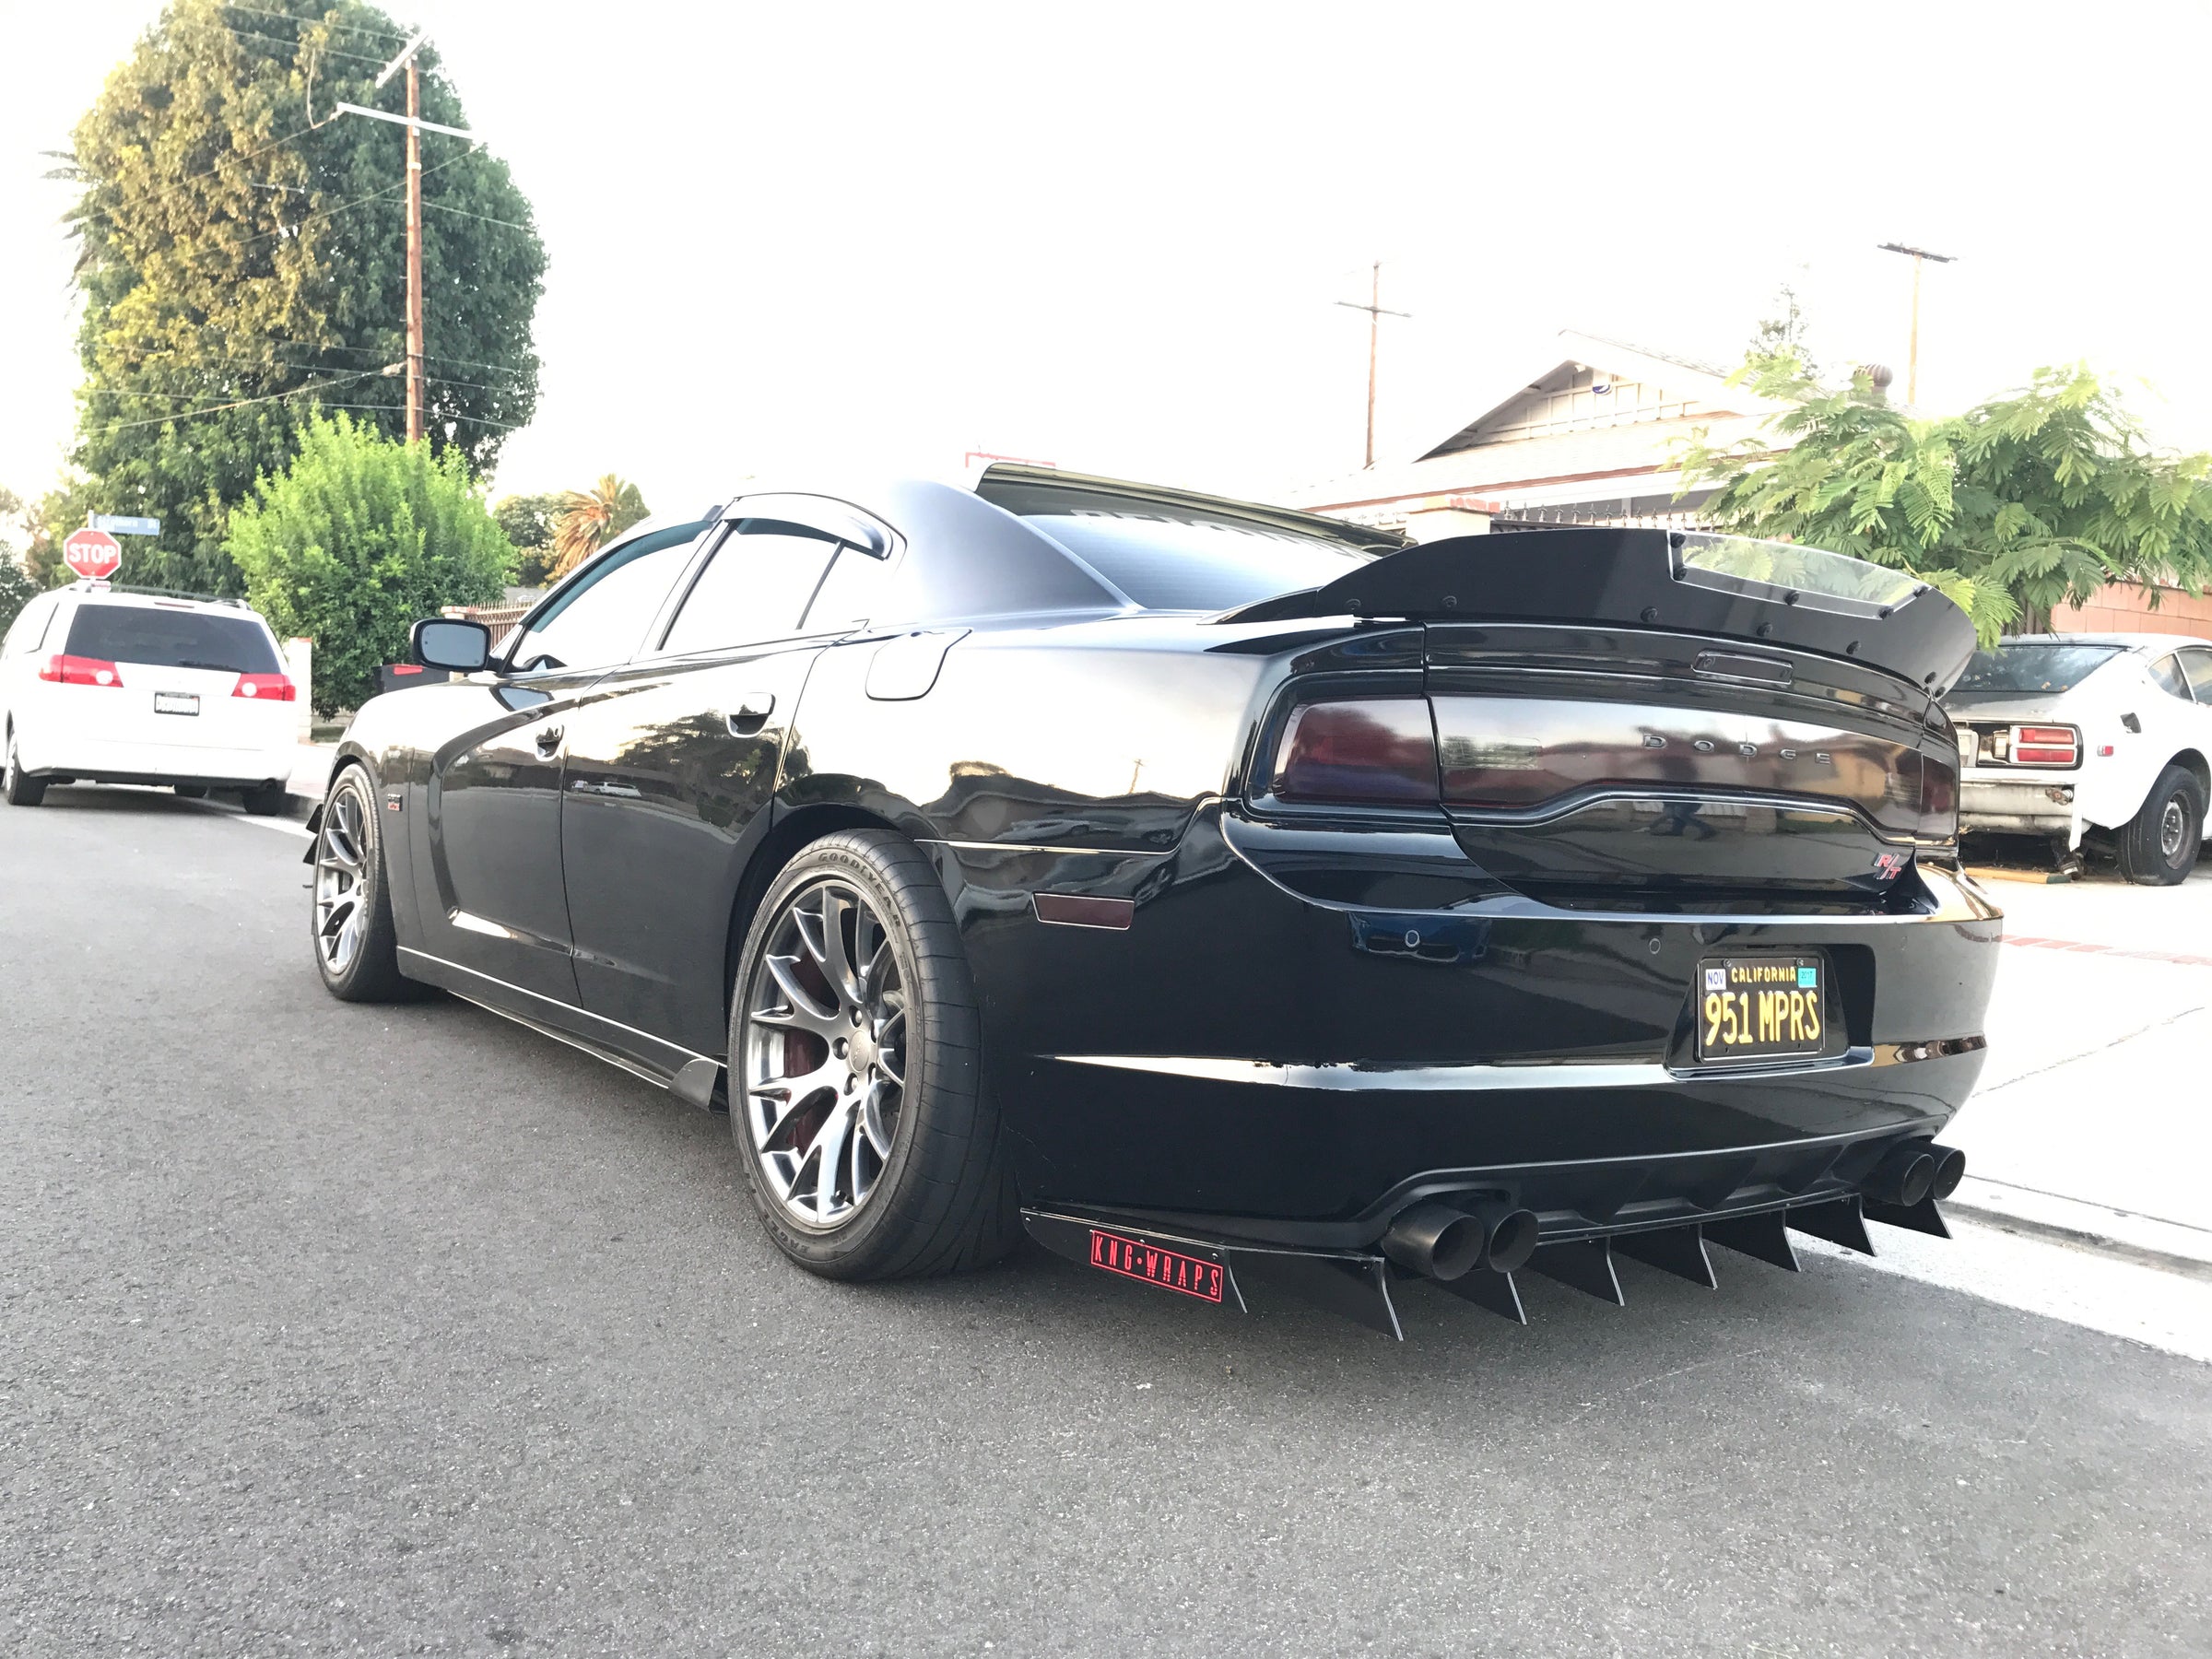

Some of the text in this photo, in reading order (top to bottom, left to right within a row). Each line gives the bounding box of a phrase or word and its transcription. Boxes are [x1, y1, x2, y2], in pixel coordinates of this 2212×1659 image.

[68, 543, 116, 564] STOP
[1643, 733, 1831, 765] DODGE
[1874, 853, 1902, 880] R/T
[818, 852, 901, 928] GOODYEAR
[1707, 971, 1724, 985] NOV
[1731, 966, 1796, 983] CALIFORNIA
[1705, 990, 1820, 1047] 951 MPRS
